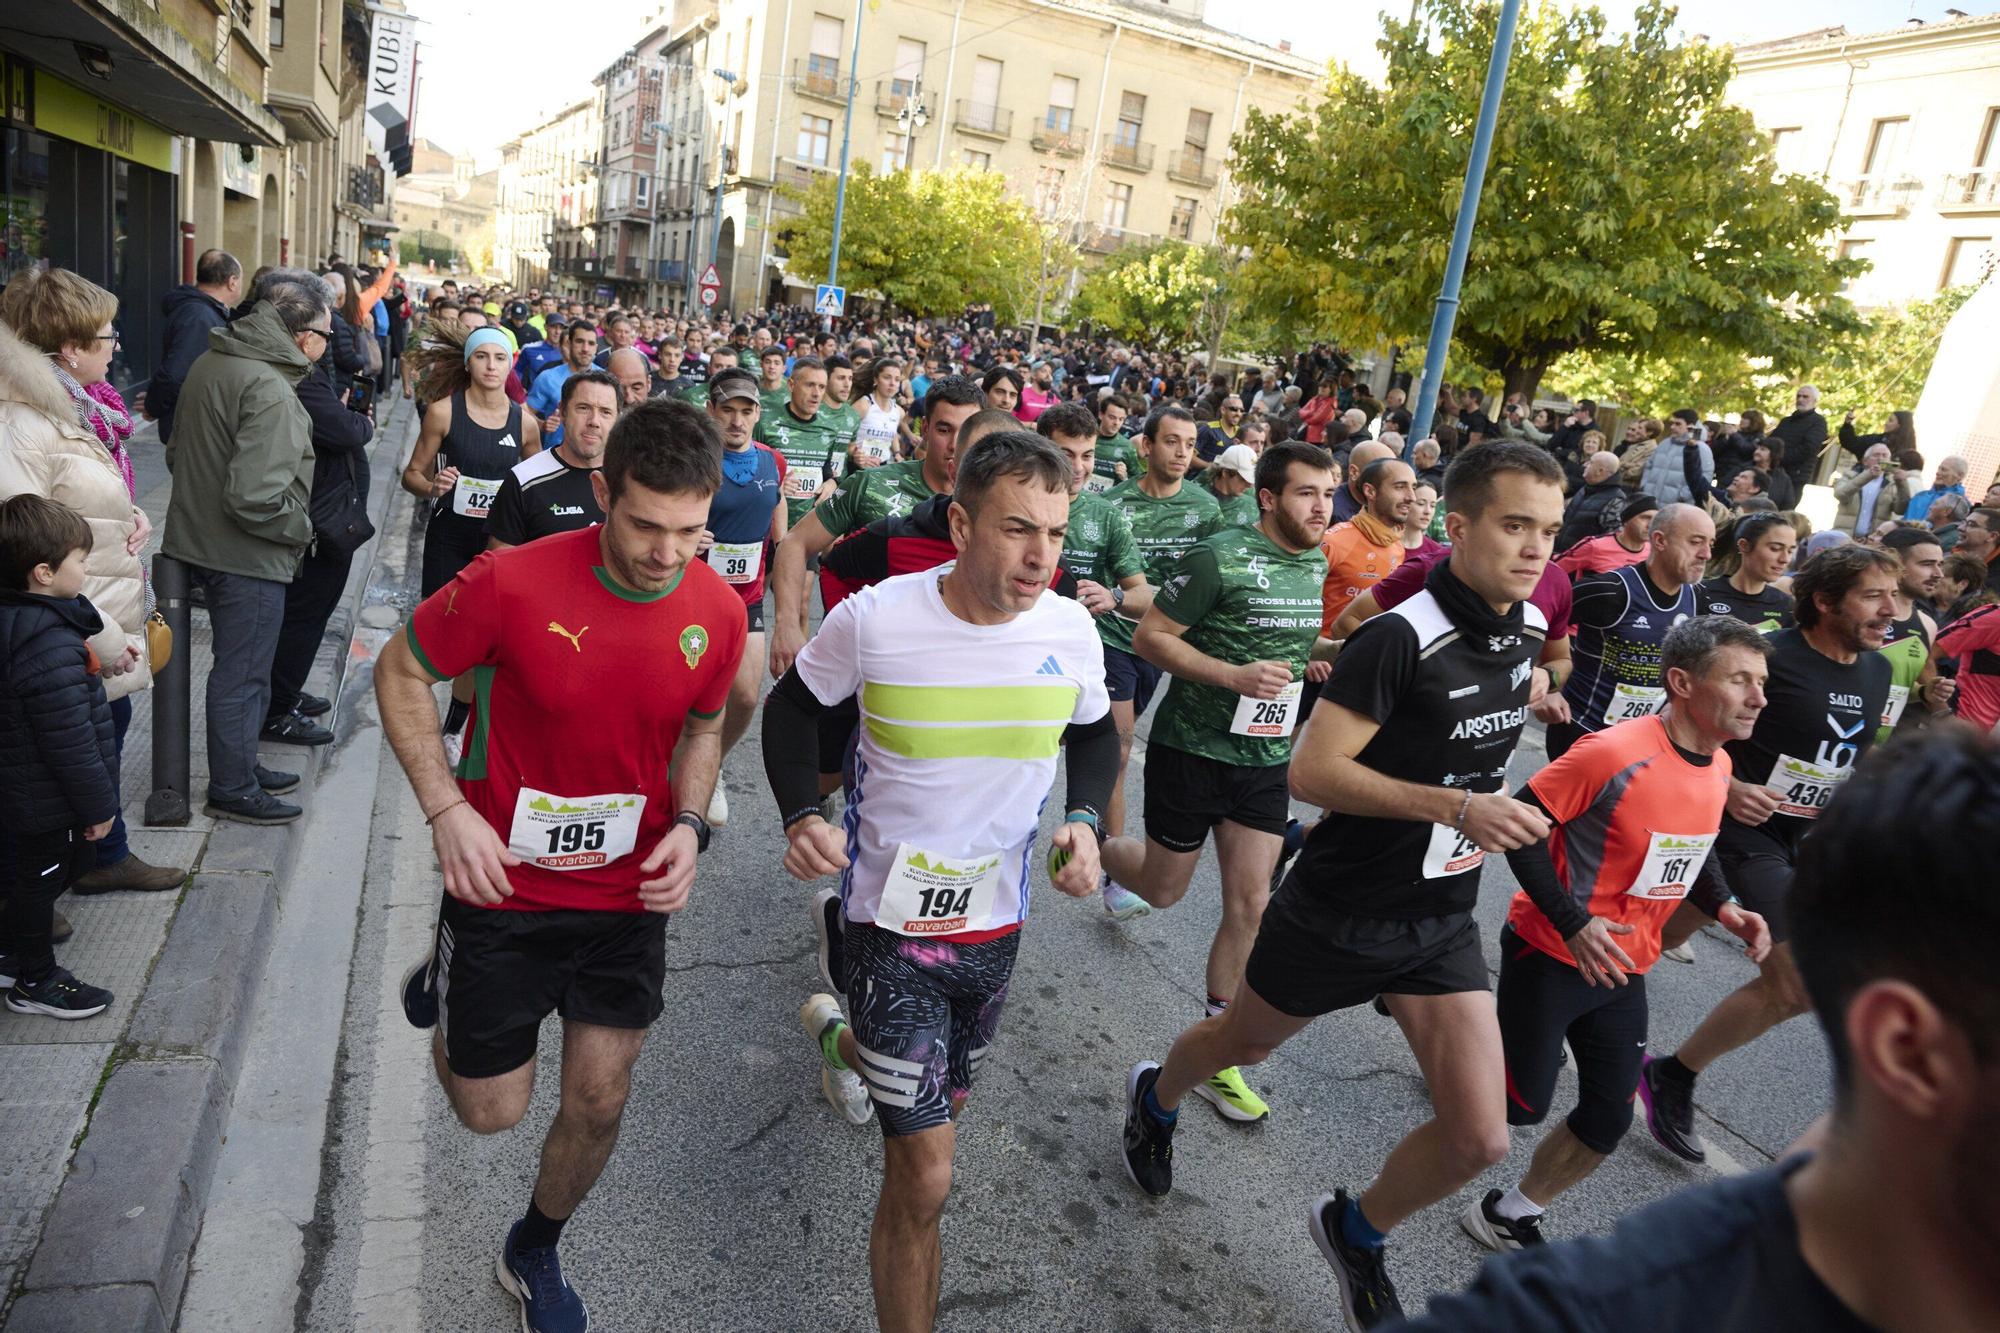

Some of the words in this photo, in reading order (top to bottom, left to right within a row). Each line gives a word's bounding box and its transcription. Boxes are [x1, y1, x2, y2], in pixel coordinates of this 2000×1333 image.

[374, 17, 402, 96] KUBE
[726, 559, 747, 574] 39
[1248, 597, 1285, 605] CROSS
[1245, 615, 1297, 628] PEÑEN
[1828, 692, 1863, 708] SALTO
[1252, 702, 1288, 724] 265
[1622, 702, 1653, 717] 268
[1786, 782, 1832, 807] 436
[546, 821, 606, 853] 195
[540, 854, 604, 866] navarban
[1661, 858, 1692, 884] 161
[919, 886, 973, 918] 194
[908, 919, 966, 931] navarban
